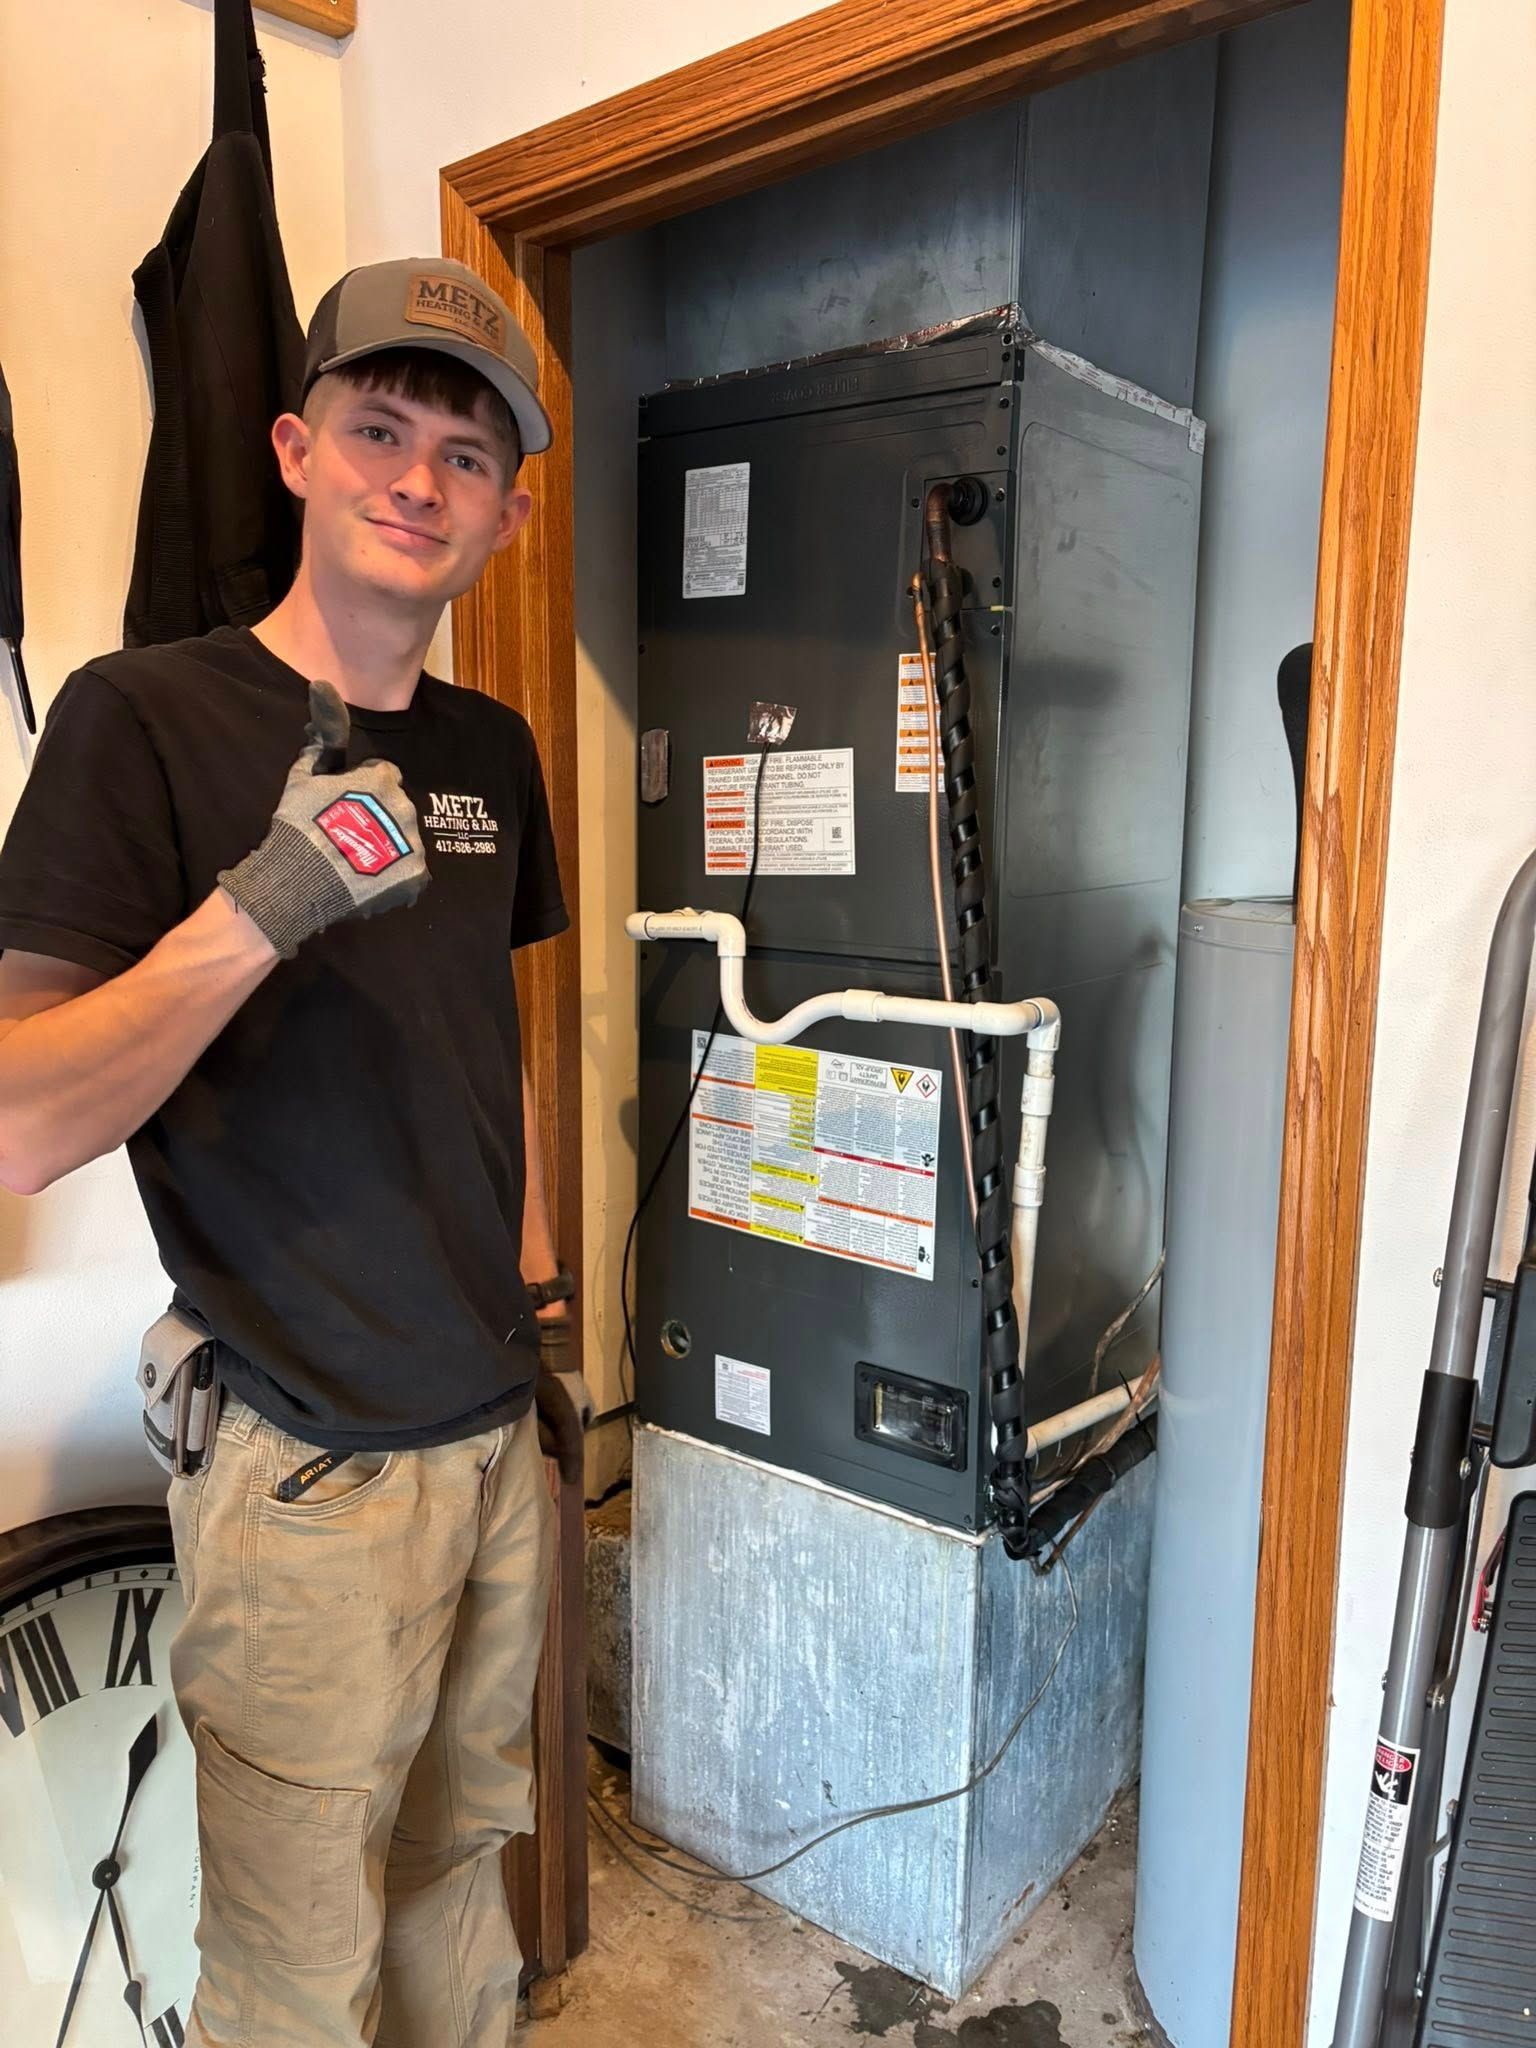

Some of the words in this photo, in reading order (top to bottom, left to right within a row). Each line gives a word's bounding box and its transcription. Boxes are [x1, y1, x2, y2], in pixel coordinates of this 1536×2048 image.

[416, 300, 471, 320] HEATING
[418, 281, 498, 331] METZ
[775, 765, 785, 773] BE
[785, 763, 817, 772] REPAIRED
[817, 762, 835, 770] ONLY
[836, 761, 845, 769] BY
[797, 772, 807, 780] DO
[808, 771, 822, 779] NOT
[429, 792, 488, 819] METZ
[423, 815, 470, 831] HEATING
[471, 818, 481, 831] &
[482, 819, 499, 832] AIR
[786, 818, 814, 826] DISPOSE
[457, 832, 469, 840] LLC
[709, 837, 735, 845] FEDERAL
[436, 839, 497, 854] 417-526-2983
[300, 1456, 333, 1485] ARIAT
[101, 1587, 169, 1690] IX
